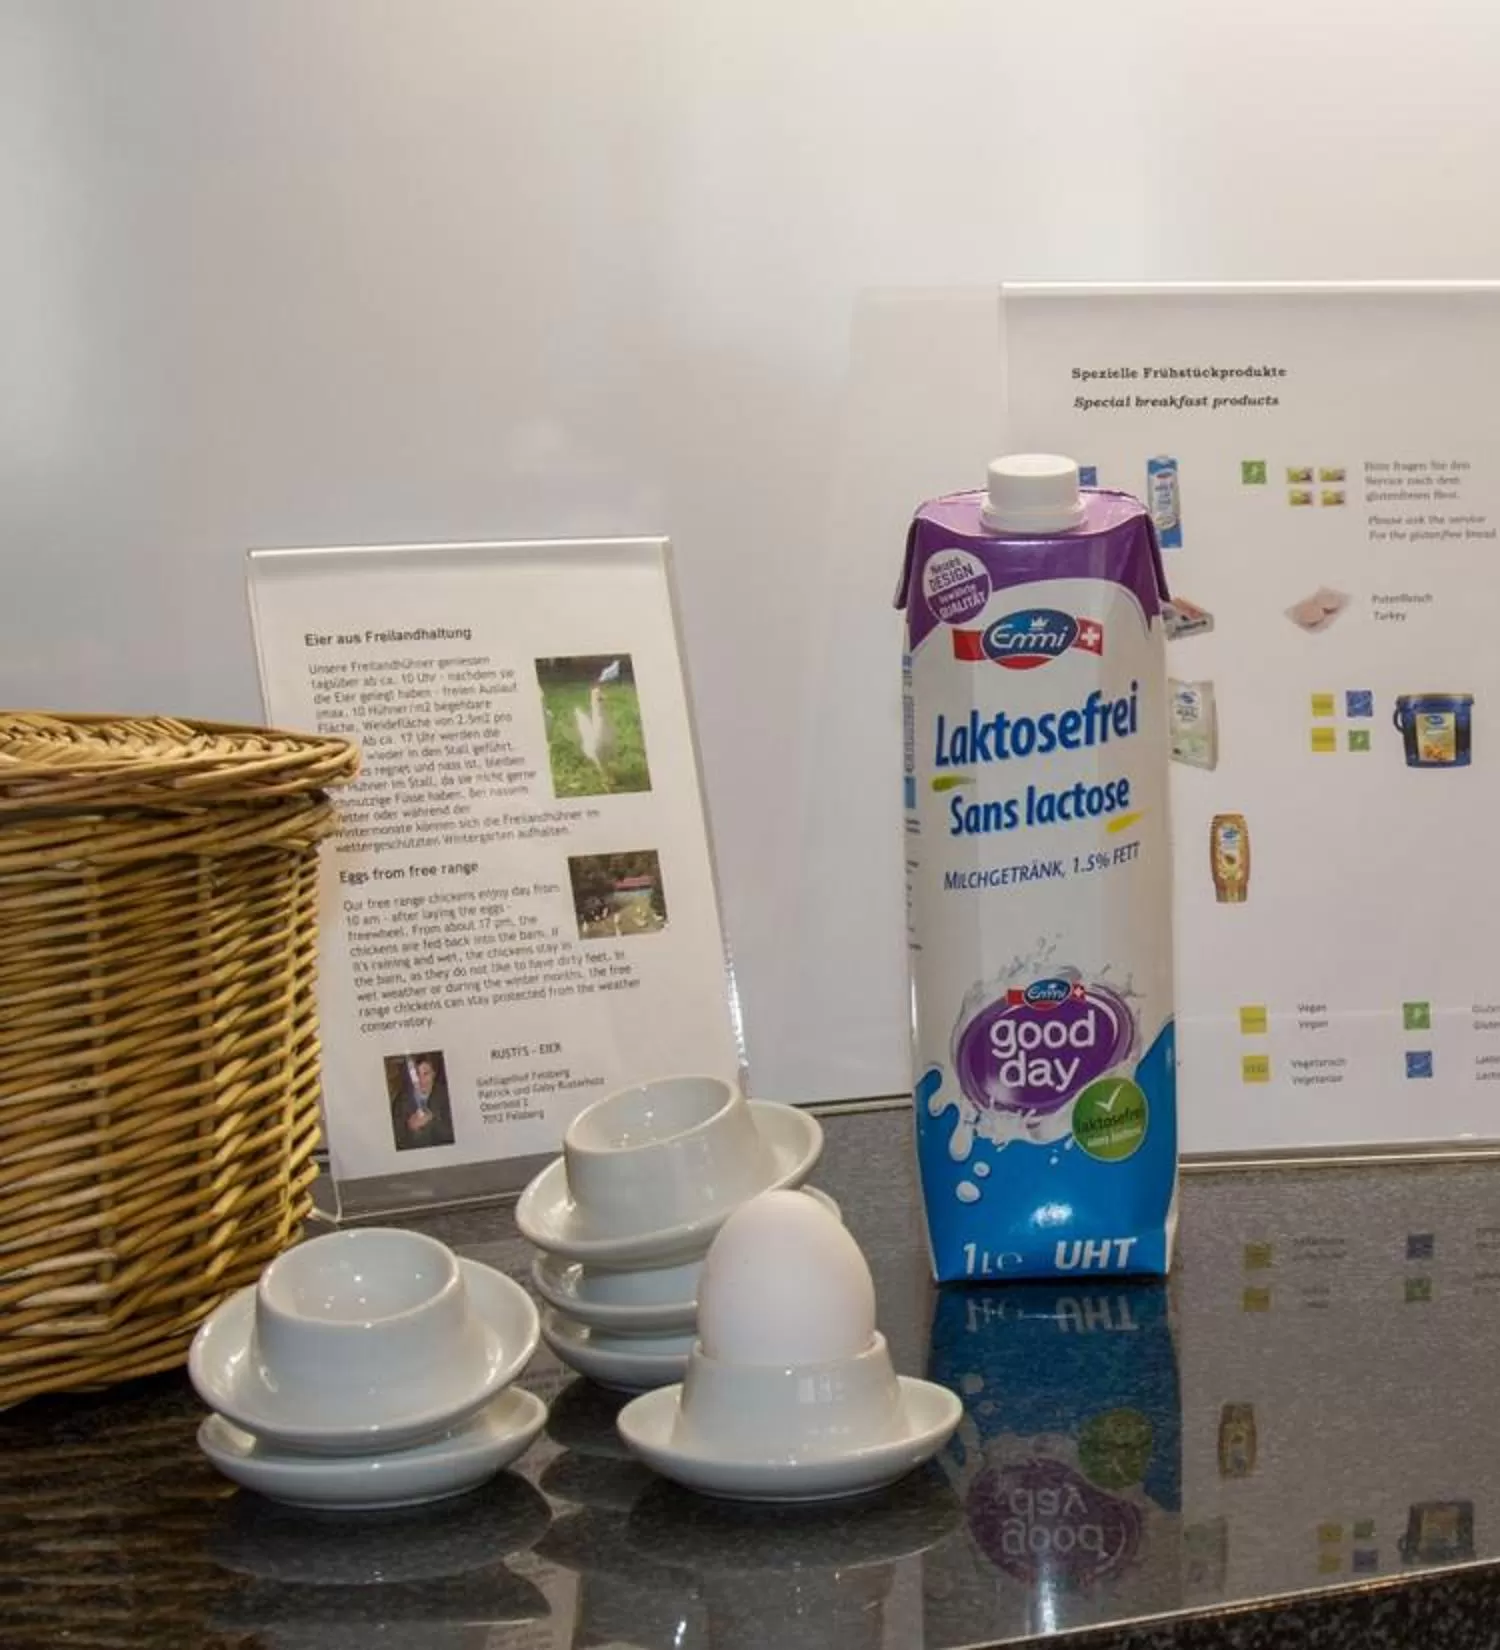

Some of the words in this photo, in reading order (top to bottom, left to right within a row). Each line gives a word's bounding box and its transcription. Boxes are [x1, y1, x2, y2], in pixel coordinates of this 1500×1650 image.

[1071, 366, 1138, 381] Spezielle
[1143, 365, 1288, 381] Frühstückprodukte
[1074, 395, 1131, 411] Special
[1135, 394, 1208, 409] breakfast
[1212, 394, 1280, 409] products
[928, 563, 974, 592] DESIGN
[304, 634, 331, 645] Eier
[337, 633, 361, 643] aus
[365, 627, 471, 642] Freilandhaltung
[989, 622, 1069, 651] Emmi
[935, 680, 1139, 768] Laktosefrei
[950, 794, 1018, 836] Sans
[1025, 776, 1131, 827] lactose
[339, 871, 368, 884] Eggs
[372, 868, 404, 879] from
[409, 865, 436, 876] free
[440, 862, 479, 875] range
[943, 858, 1066, 891] MILCHGETRÄNK,
[1073, 849, 1111, 874] 1.5%
[1113, 842, 1141, 865] FETT
[1027, 982, 1071, 1002] Emmi
[990, 1010, 1096, 1058] good
[999, 1053, 1081, 1092] day
[1055, 1236, 1138, 1270] UHT
